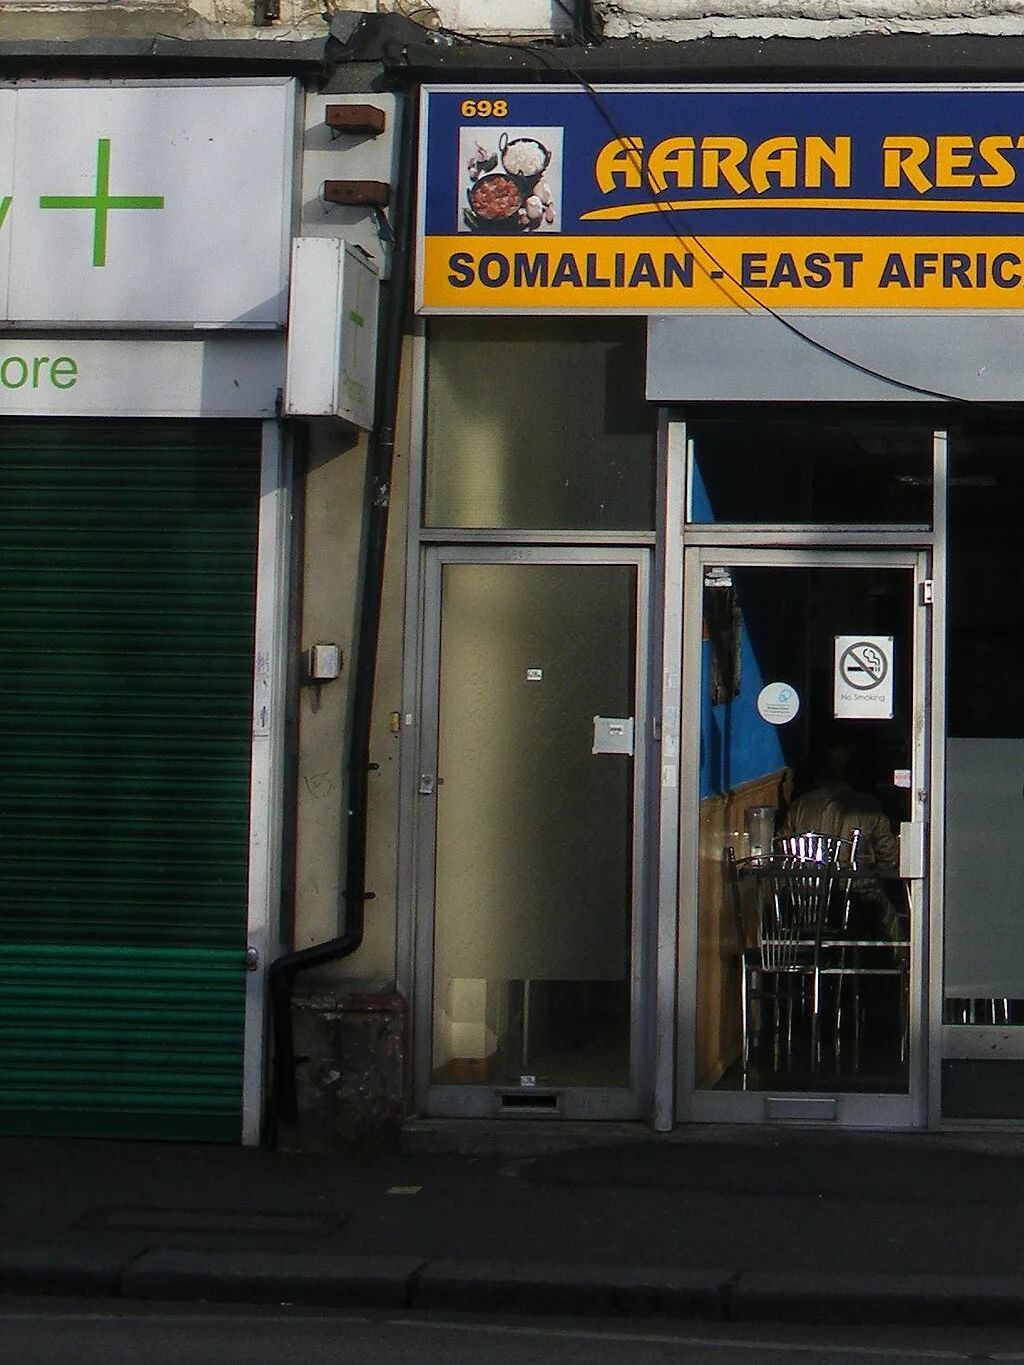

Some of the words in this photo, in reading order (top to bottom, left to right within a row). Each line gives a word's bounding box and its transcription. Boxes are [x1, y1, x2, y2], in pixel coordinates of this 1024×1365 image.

[460, 99, 509, 117] 698
[595, 136, 852, 195] AARAN
[448, 252, 695, 288] SOMALIAN
[740, 252, 863, 288] EAST
[1, 356, 78, 390] ore
[841, 693, 852, 701] No
[854, 692, 886, 703] Smoking
